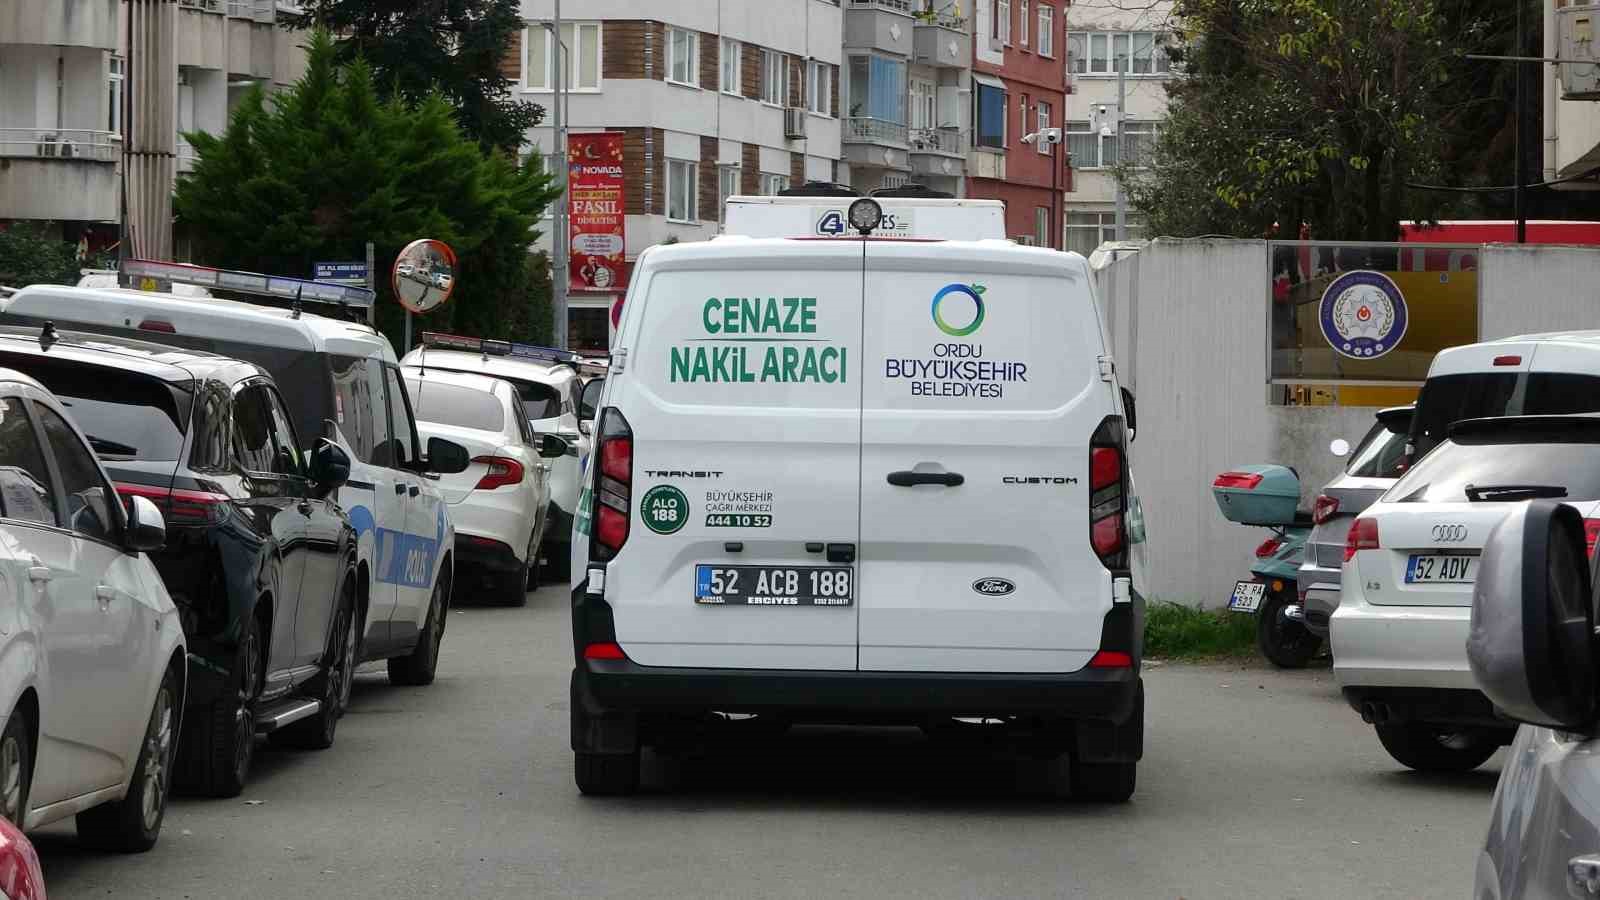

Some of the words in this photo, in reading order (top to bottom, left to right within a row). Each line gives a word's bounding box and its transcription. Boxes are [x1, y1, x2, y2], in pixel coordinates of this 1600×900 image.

[583, 166, 622, 175] NOVADA
[572, 200, 622, 215] FASIL
[702, 297, 817, 334] CENAZE
[933, 343, 983, 358] ORDU
[760, 346, 847, 383] ARACI
[886, 359, 1027, 382] BÜYÜKŞEHİR
[644, 470, 724, 478] TRANSIT
[1002, 476, 1078, 484] CUSTOM
[652, 498, 678, 509] ALO
[705, 490, 774, 504] BÜYÜKŞEHİR
[652, 509, 678, 522] 188
[707, 515, 731, 526] 444
[735, 515, 751, 526] 10
[754, 515, 770, 526] 52
[1415, 557, 1434, 580] 52
[1439, 557, 1471, 580] ADV
[711, 569, 739, 595] 52
[755, 569, 799, 596] ACB
[810, 570, 849, 596] 188
[982, 580, 1007, 592] Ford
[1237, 584, 1248, 595] 52
[1251, 585, 1263, 595] RA
[1236, 596, 1253, 607] 523
